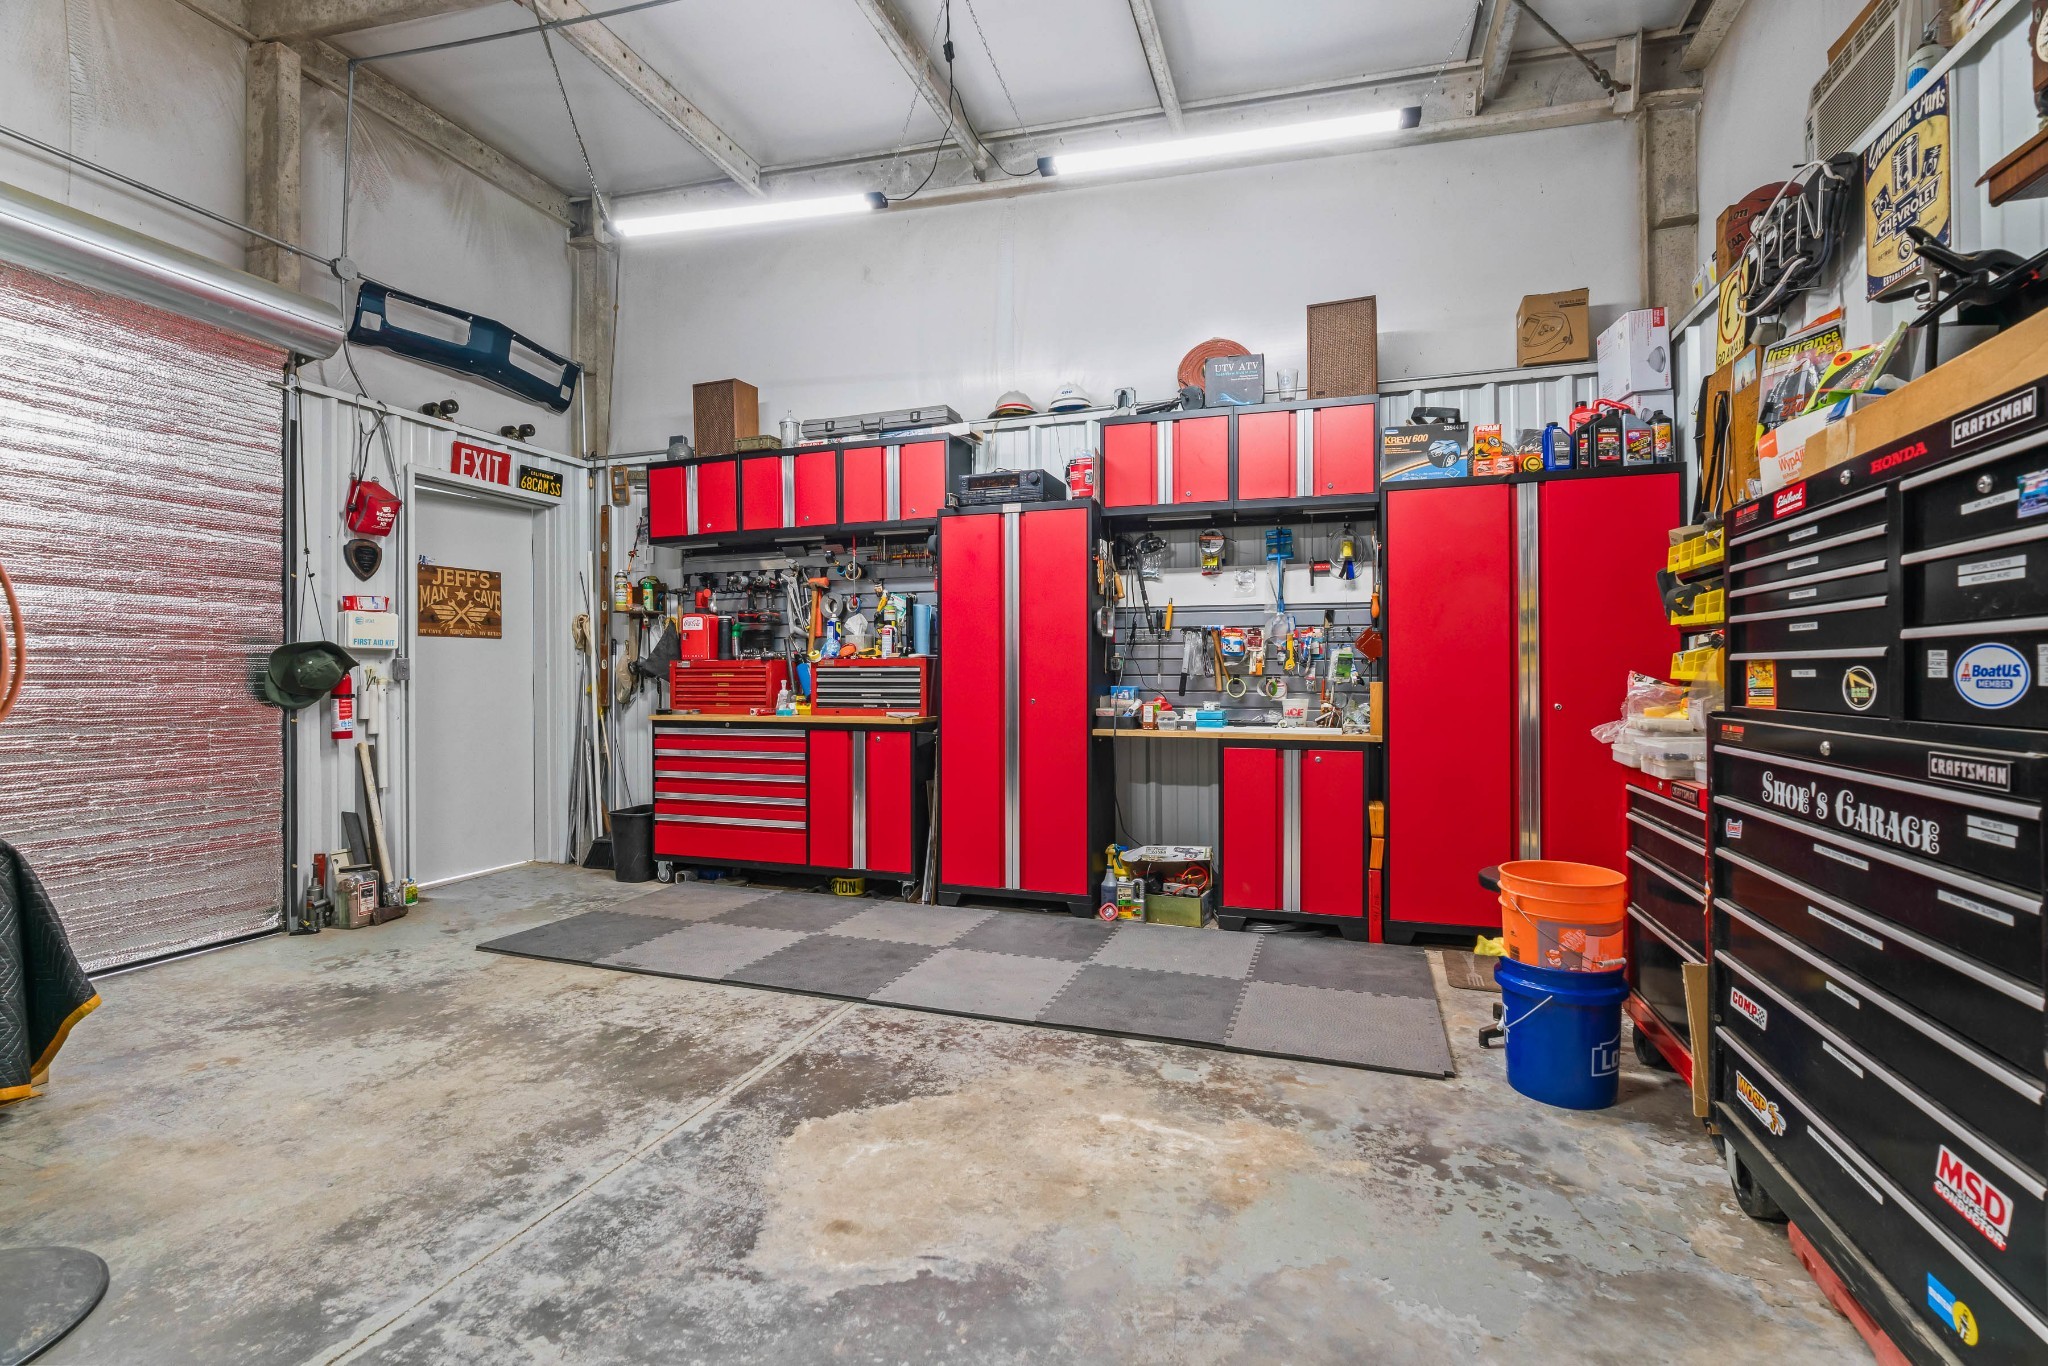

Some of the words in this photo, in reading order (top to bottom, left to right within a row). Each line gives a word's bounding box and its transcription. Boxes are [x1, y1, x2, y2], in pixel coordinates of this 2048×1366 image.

[1868, 109, 1912, 170] Genuine
[1914, 84, 1946, 120] Parts
[1878, 182, 1937, 237] CHEVROLET
[1883, 260, 1917, 287] ESTABLISHED
[1766, 330, 1839, 363] Insurance
[1214, 363, 1235, 373] UTV
[1238, 361, 1259, 371] ATV
[1477, 424, 1500, 432] FRAM
[1954, 393, 2033, 441] CRAFTSMAN
[1384, 435, 1412, 444] KREW
[1412, 434, 1429, 443] 600
[460, 447, 503, 485] EXIT
[1870, 441, 1928, 475] HONDA
[521, 476, 549, 494] 68CAM
[550, 482, 561, 497] SS
[432, 567, 491, 589] JEFF'S
[419, 584, 449, 612] MAN
[473, 589, 501, 617] CAVE
[353, 638, 371, 646] FIRST
[1978, 679, 2011, 688] MEMBER
[1284, 708, 1304, 716] ACE
[1931, 758, 2007, 785] CRAFTSMAN
[1732, 991, 1757, 1016] COMP
[1737, 1073, 1767, 1113] WOSP
[1938, 1149, 2006, 1226] MSD
